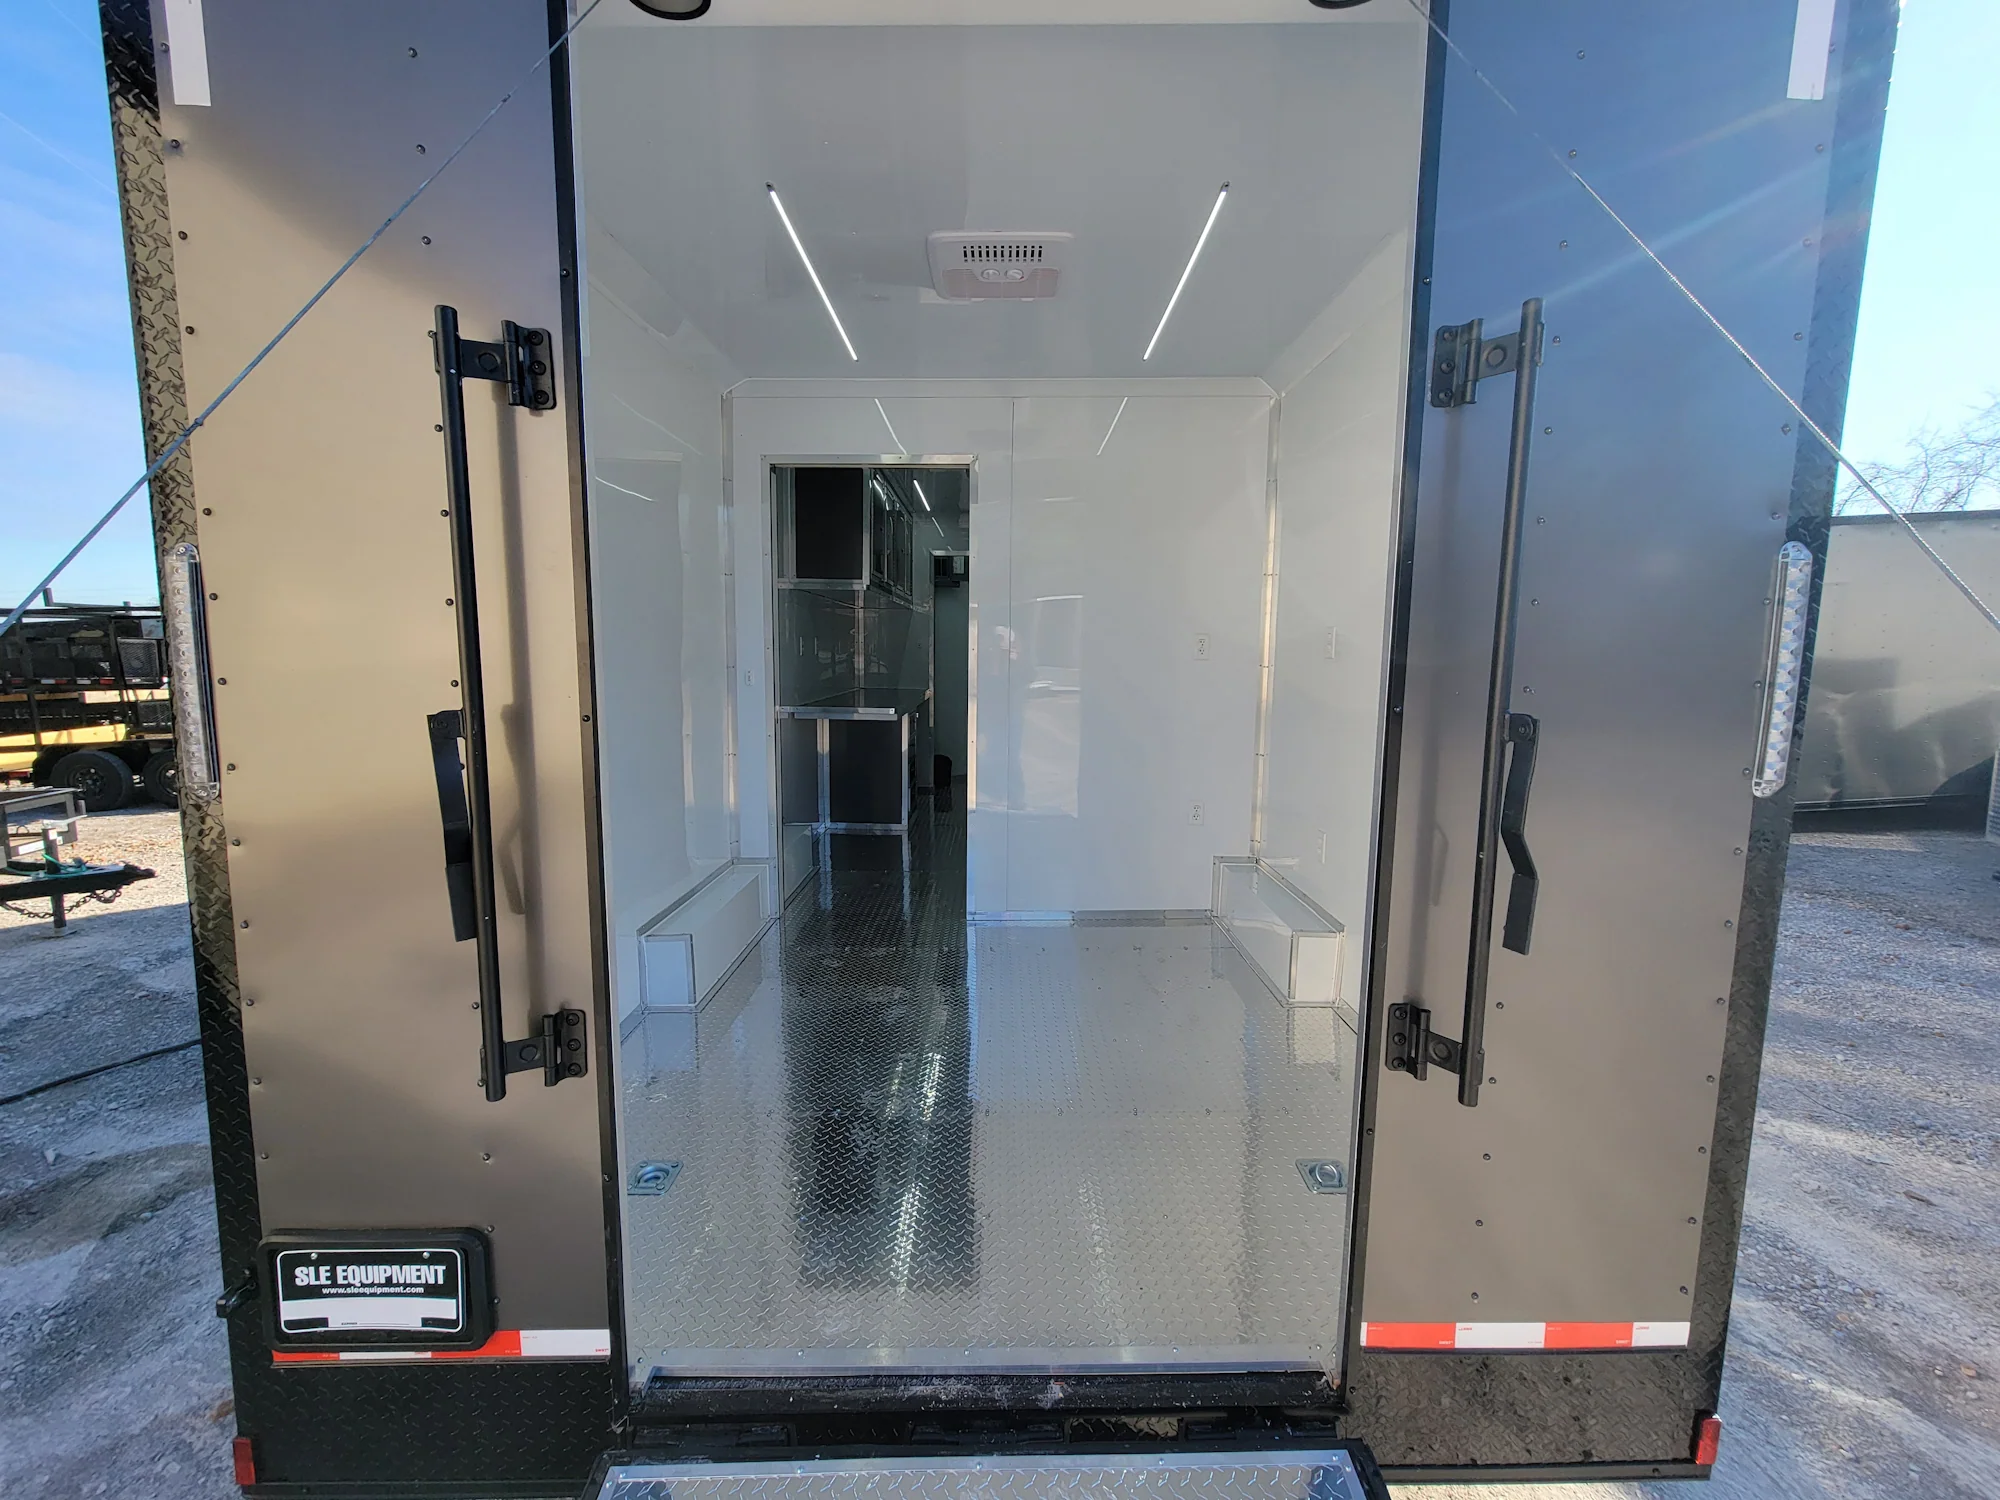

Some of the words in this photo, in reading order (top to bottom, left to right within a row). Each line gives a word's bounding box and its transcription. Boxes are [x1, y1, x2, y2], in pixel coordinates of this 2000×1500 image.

[295, 1266, 331, 1286] SLE
[336, 1265, 446, 1286] EQUIPMENT
[322, 1286, 424, 1295] www.sleequipment.com
